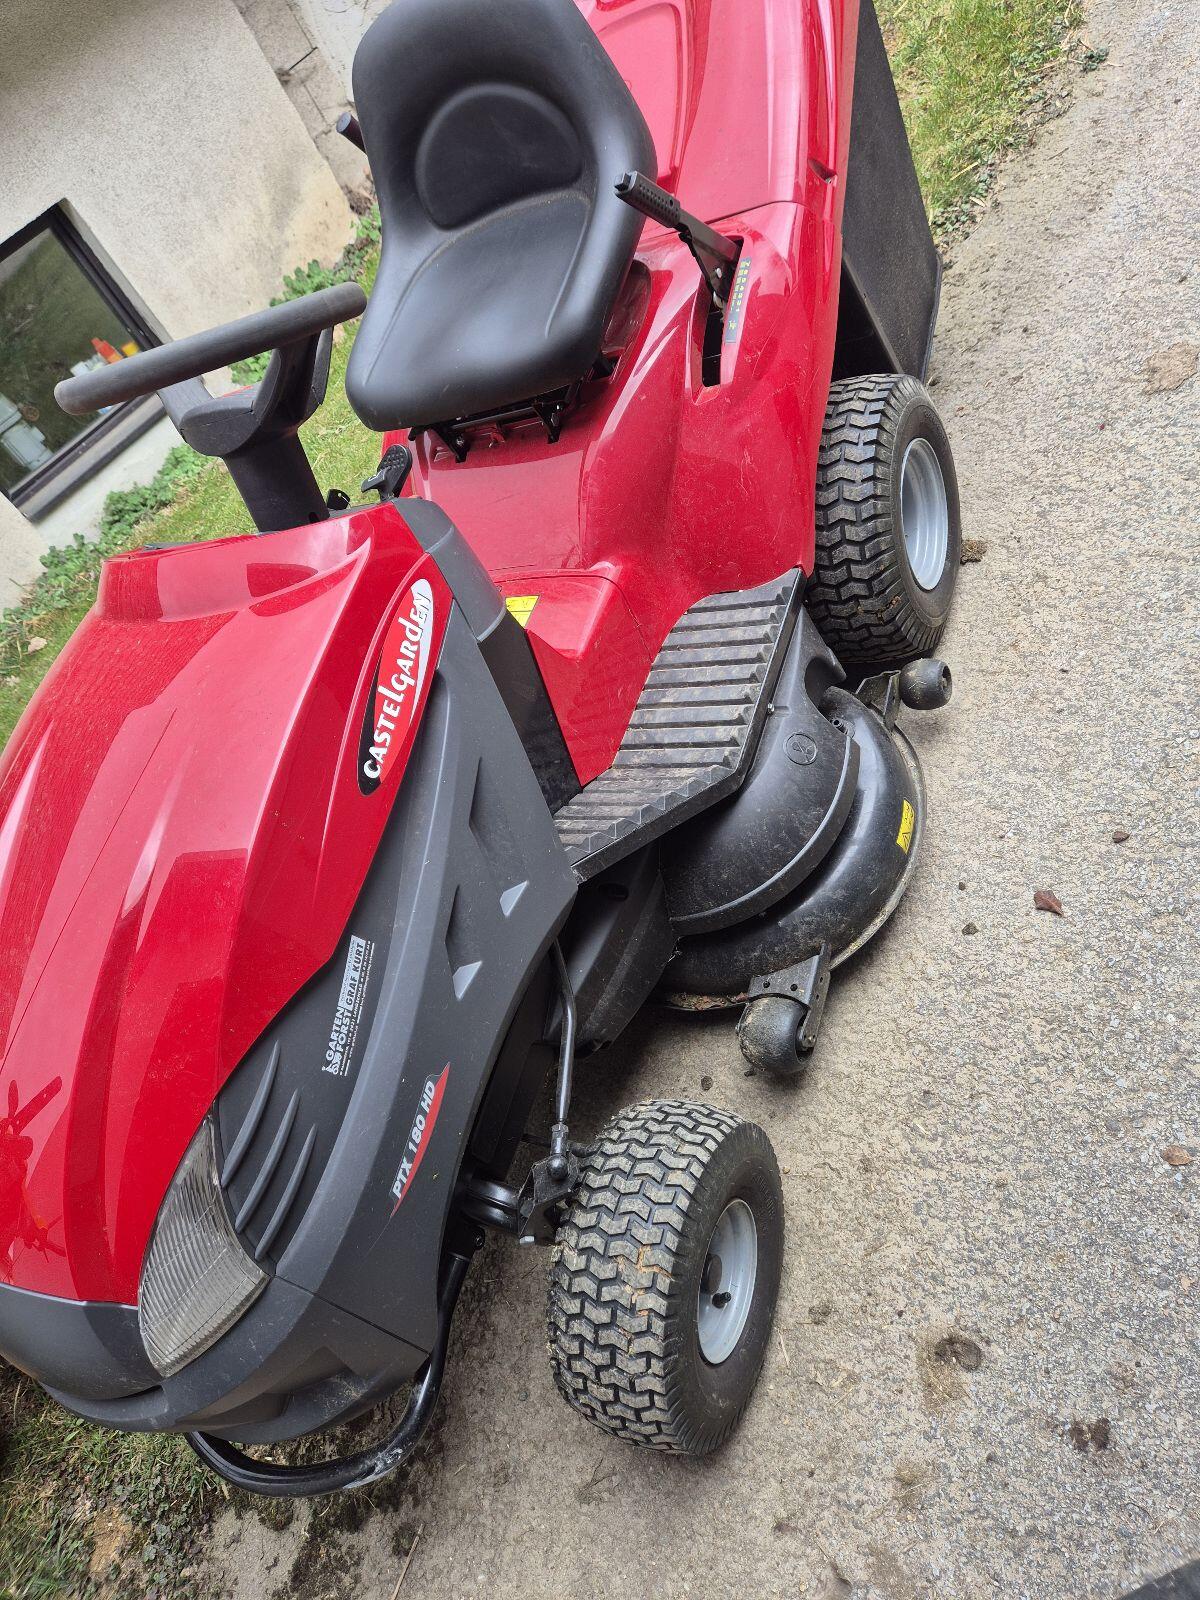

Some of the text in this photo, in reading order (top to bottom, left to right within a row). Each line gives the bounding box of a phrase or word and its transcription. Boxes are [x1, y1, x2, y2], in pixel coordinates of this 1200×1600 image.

[325, 1006, 345, 1061] GARTEN
[335, 1009, 352, 1051] FORST
[346, 978, 358, 1006] GRAF
[352, 942, 365, 970] KURT
[392, 1080, 435, 1199] PTX 180 HD
